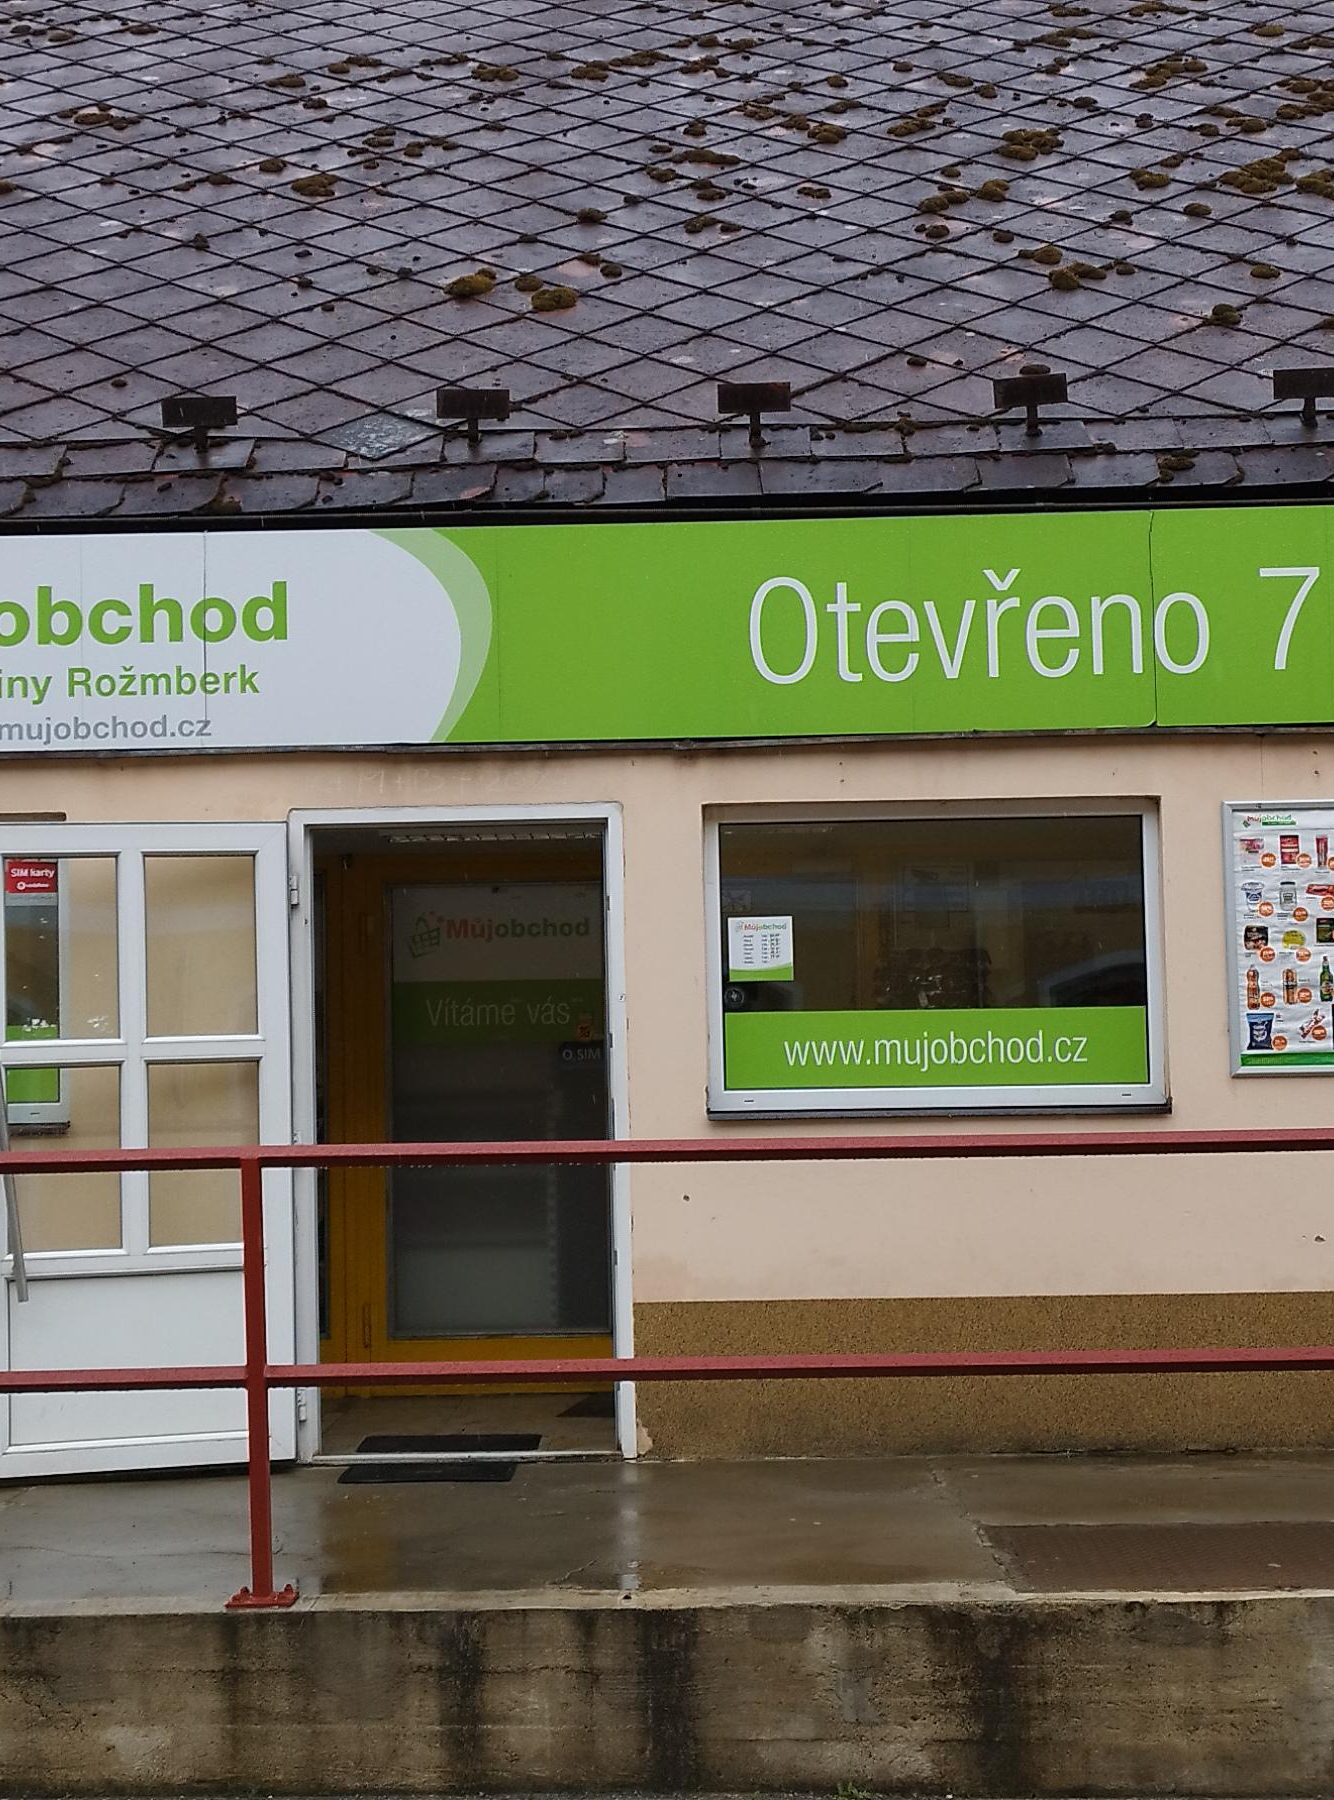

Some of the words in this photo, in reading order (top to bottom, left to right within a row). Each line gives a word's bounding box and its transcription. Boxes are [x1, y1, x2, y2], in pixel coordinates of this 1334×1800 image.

[748, 567, 1211, 685] Otevřeno
[1258, 565, 1320, 671] 7
[67, 664, 261, 698] Rožmberk
[10, 868, 28, 878] SIM
[446, 918, 590, 943] Můjobchod
[426, 997, 516, 1027] Vítáme
[527, 996, 571, 1025] vás
[783, 1029, 1088, 1073] www.mujobchod.cz
